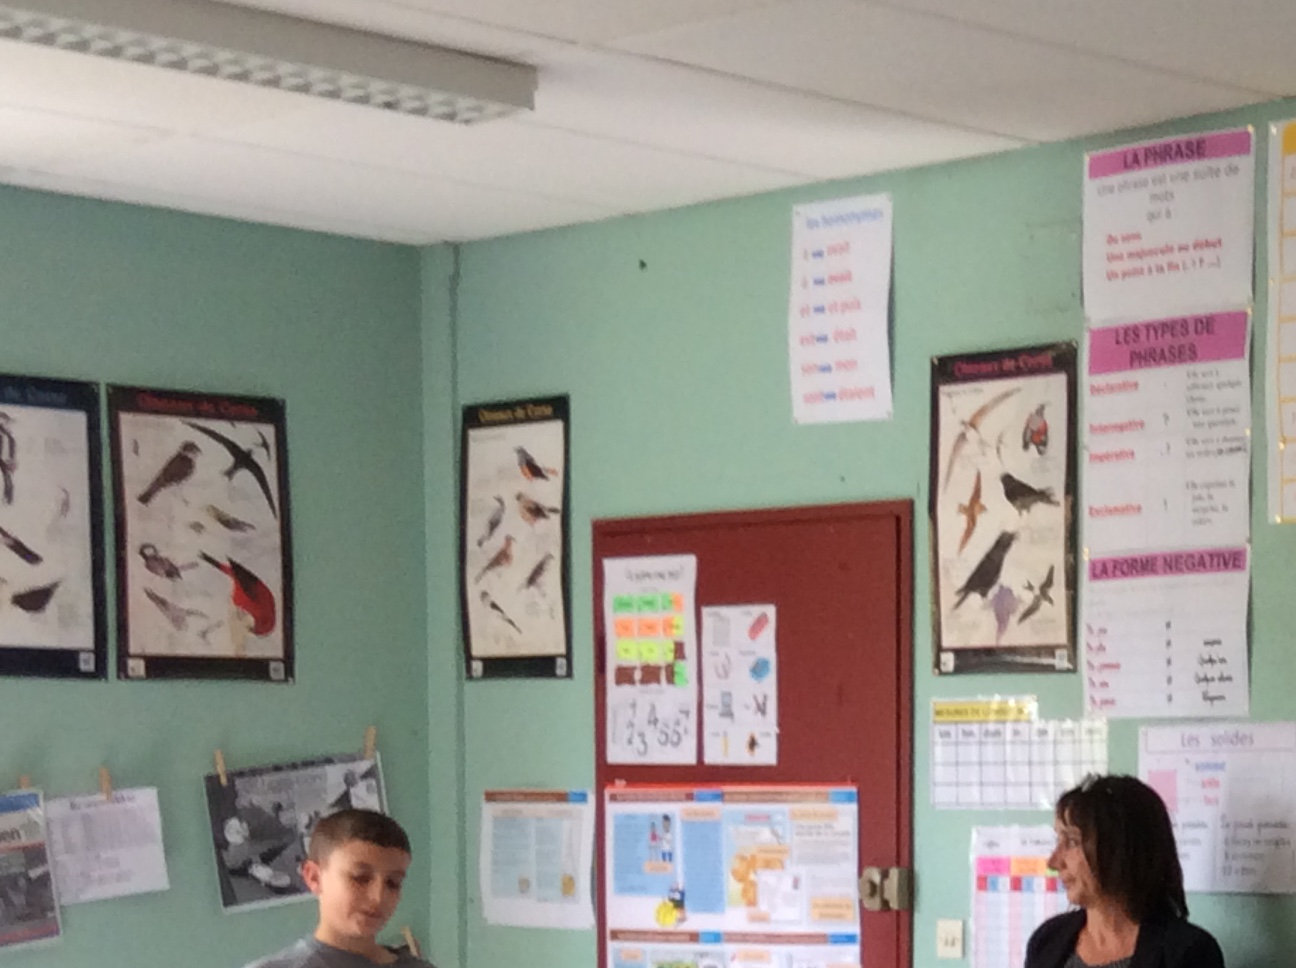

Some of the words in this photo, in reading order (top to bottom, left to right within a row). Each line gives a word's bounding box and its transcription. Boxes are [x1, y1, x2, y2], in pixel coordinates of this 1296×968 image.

[1123, 150, 1140, 170] LA
[1144, 139, 1206, 166] PHRASE
[1115, 326, 1140, 345] LES
[1145, 320, 1190, 342] TYPES
[1194, 317, 1215, 336] DE
[1129, 343, 1198, 368] PHRASES
[1092, 561, 1108, 579] LA
[1111, 557, 1157, 577] FORME
[1162, 551, 1242, 573] NEGATIVE
[1181, 733, 1200, 748] Les
[1211, 730, 1254, 747] solides
